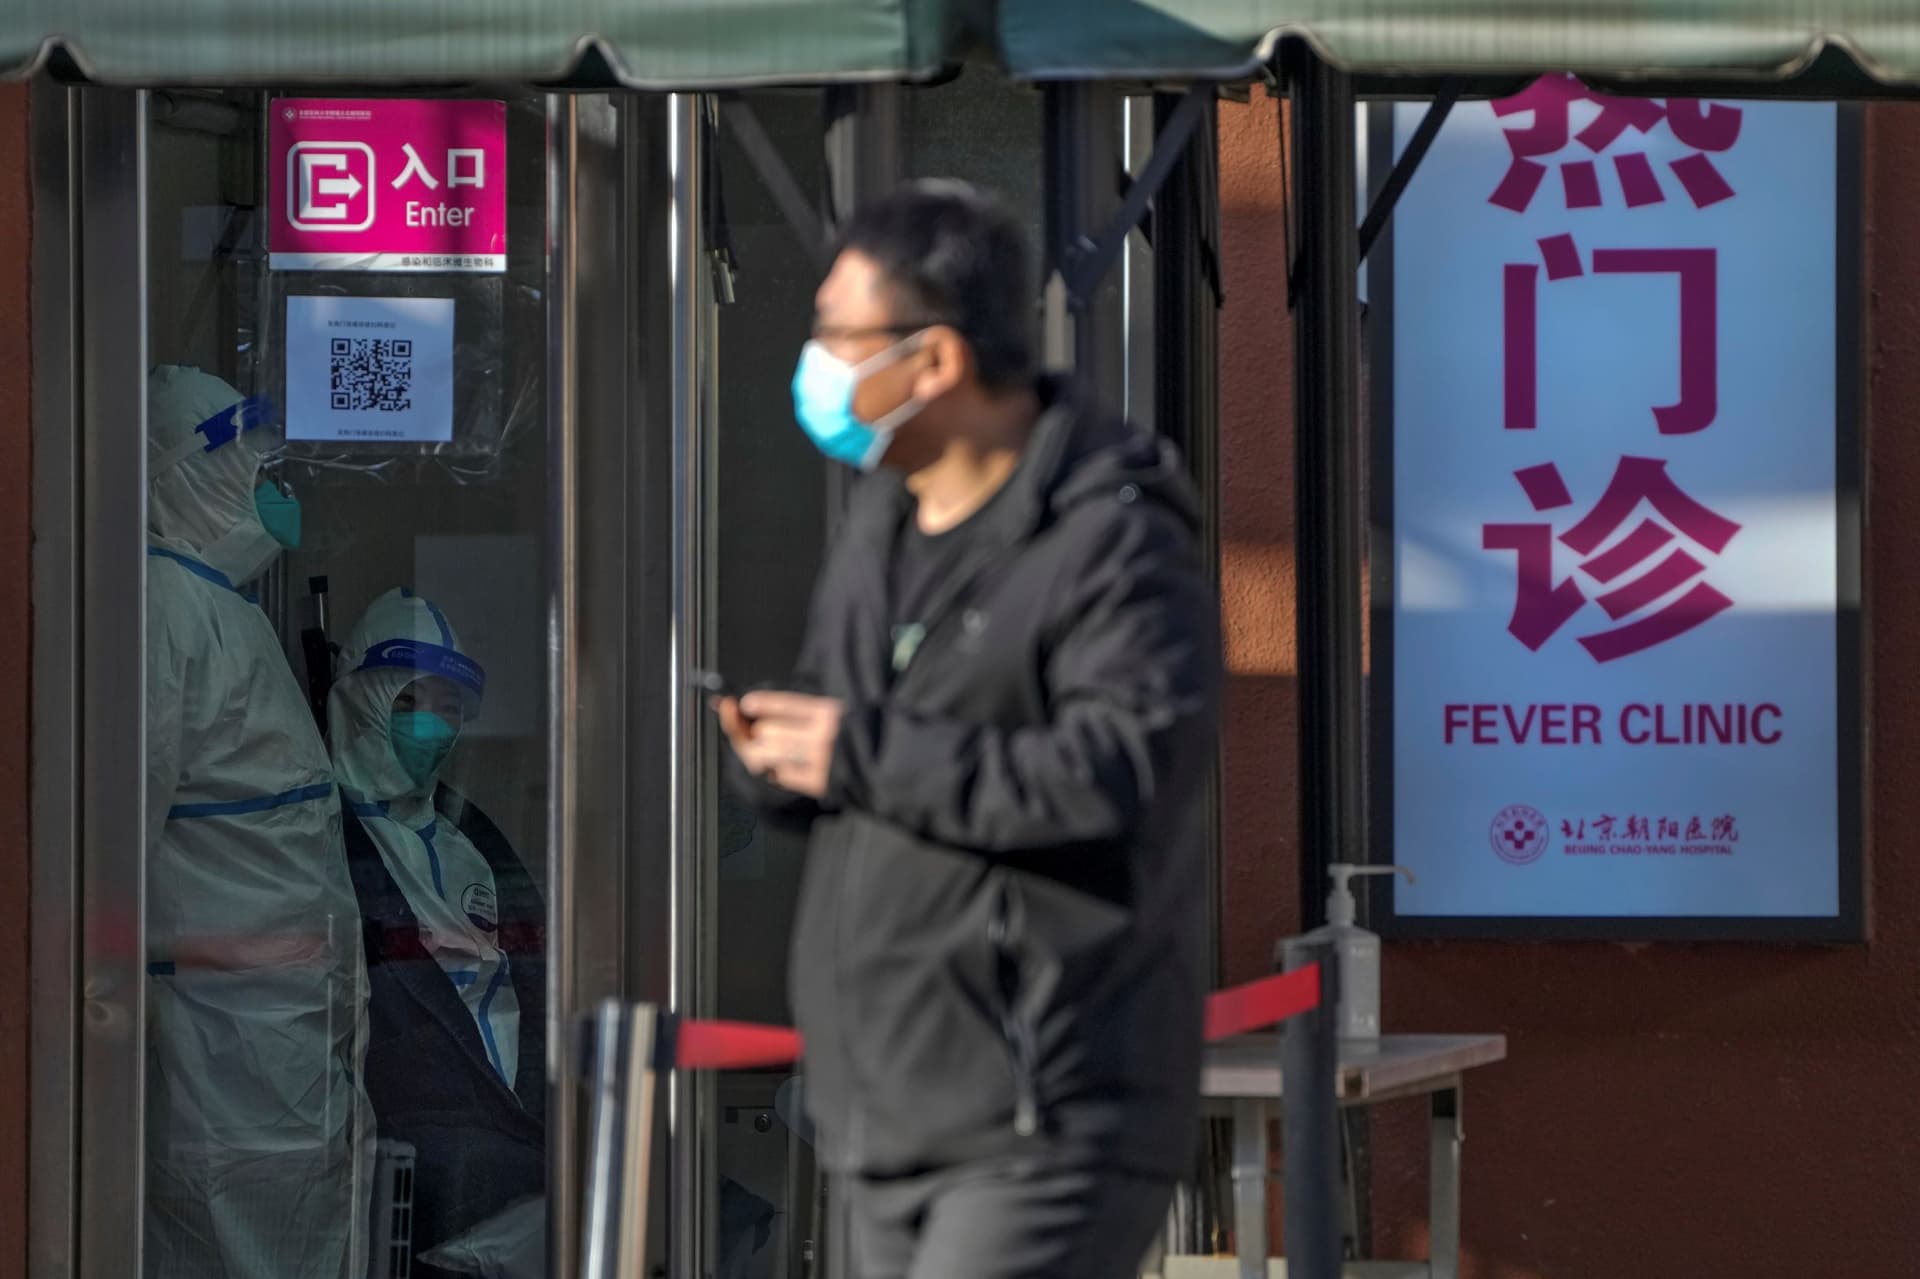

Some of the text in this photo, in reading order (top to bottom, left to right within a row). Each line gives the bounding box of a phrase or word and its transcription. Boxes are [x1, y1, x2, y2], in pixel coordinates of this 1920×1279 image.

[391, 142, 484, 190] 入口
[405, 201, 476, 227] Enter
[1482, 72, 1742, 664] 热门诊
[1444, 703, 1783, 745] FEVER CLINIC
[1560, 814, 1739, 842] 北京朝阳医院
[1564, 844, 1605, 856] BEIJING
[1680, 844, 1734, 856] HOSPITAL
